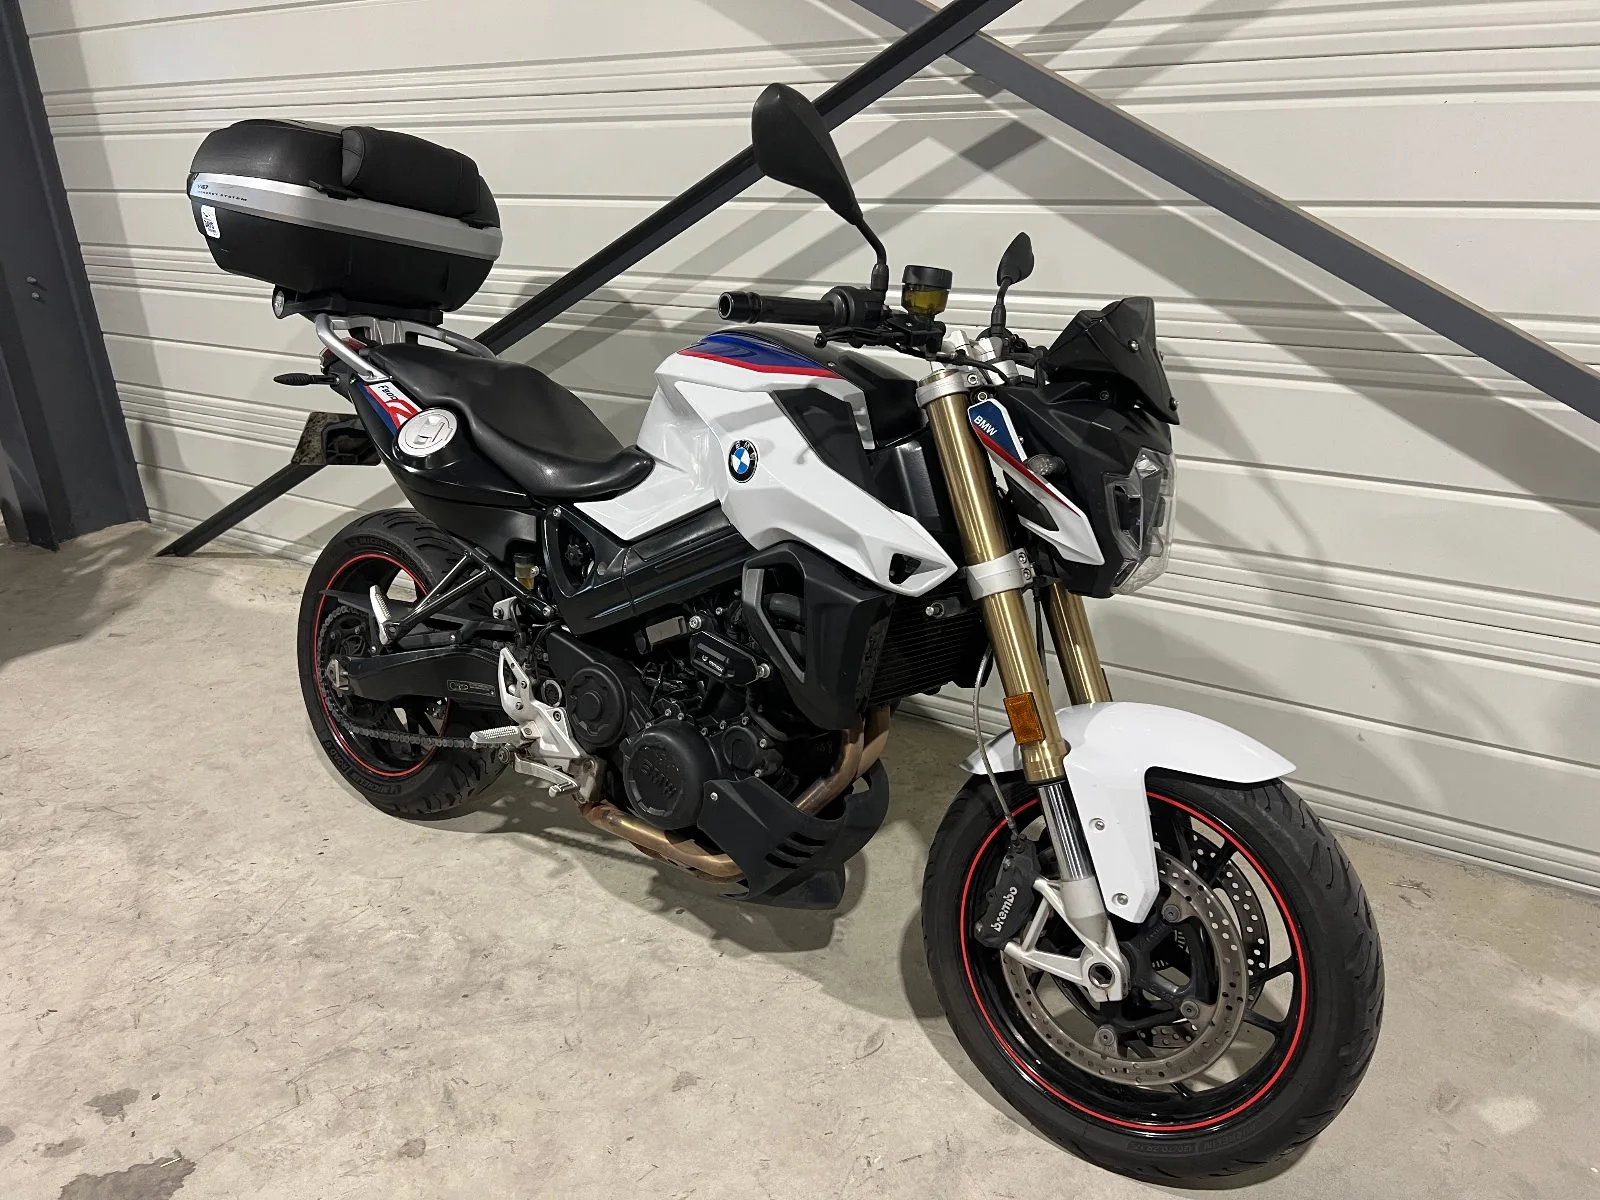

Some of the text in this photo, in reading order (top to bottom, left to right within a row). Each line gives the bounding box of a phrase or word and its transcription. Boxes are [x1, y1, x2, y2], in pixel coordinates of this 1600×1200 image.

[973, 415, 998, 436] BMW
[328, 749, 350, 773] ROAD
[640, 758, 677, 799] BMW
[990, 886, 1018, 932] brembo
